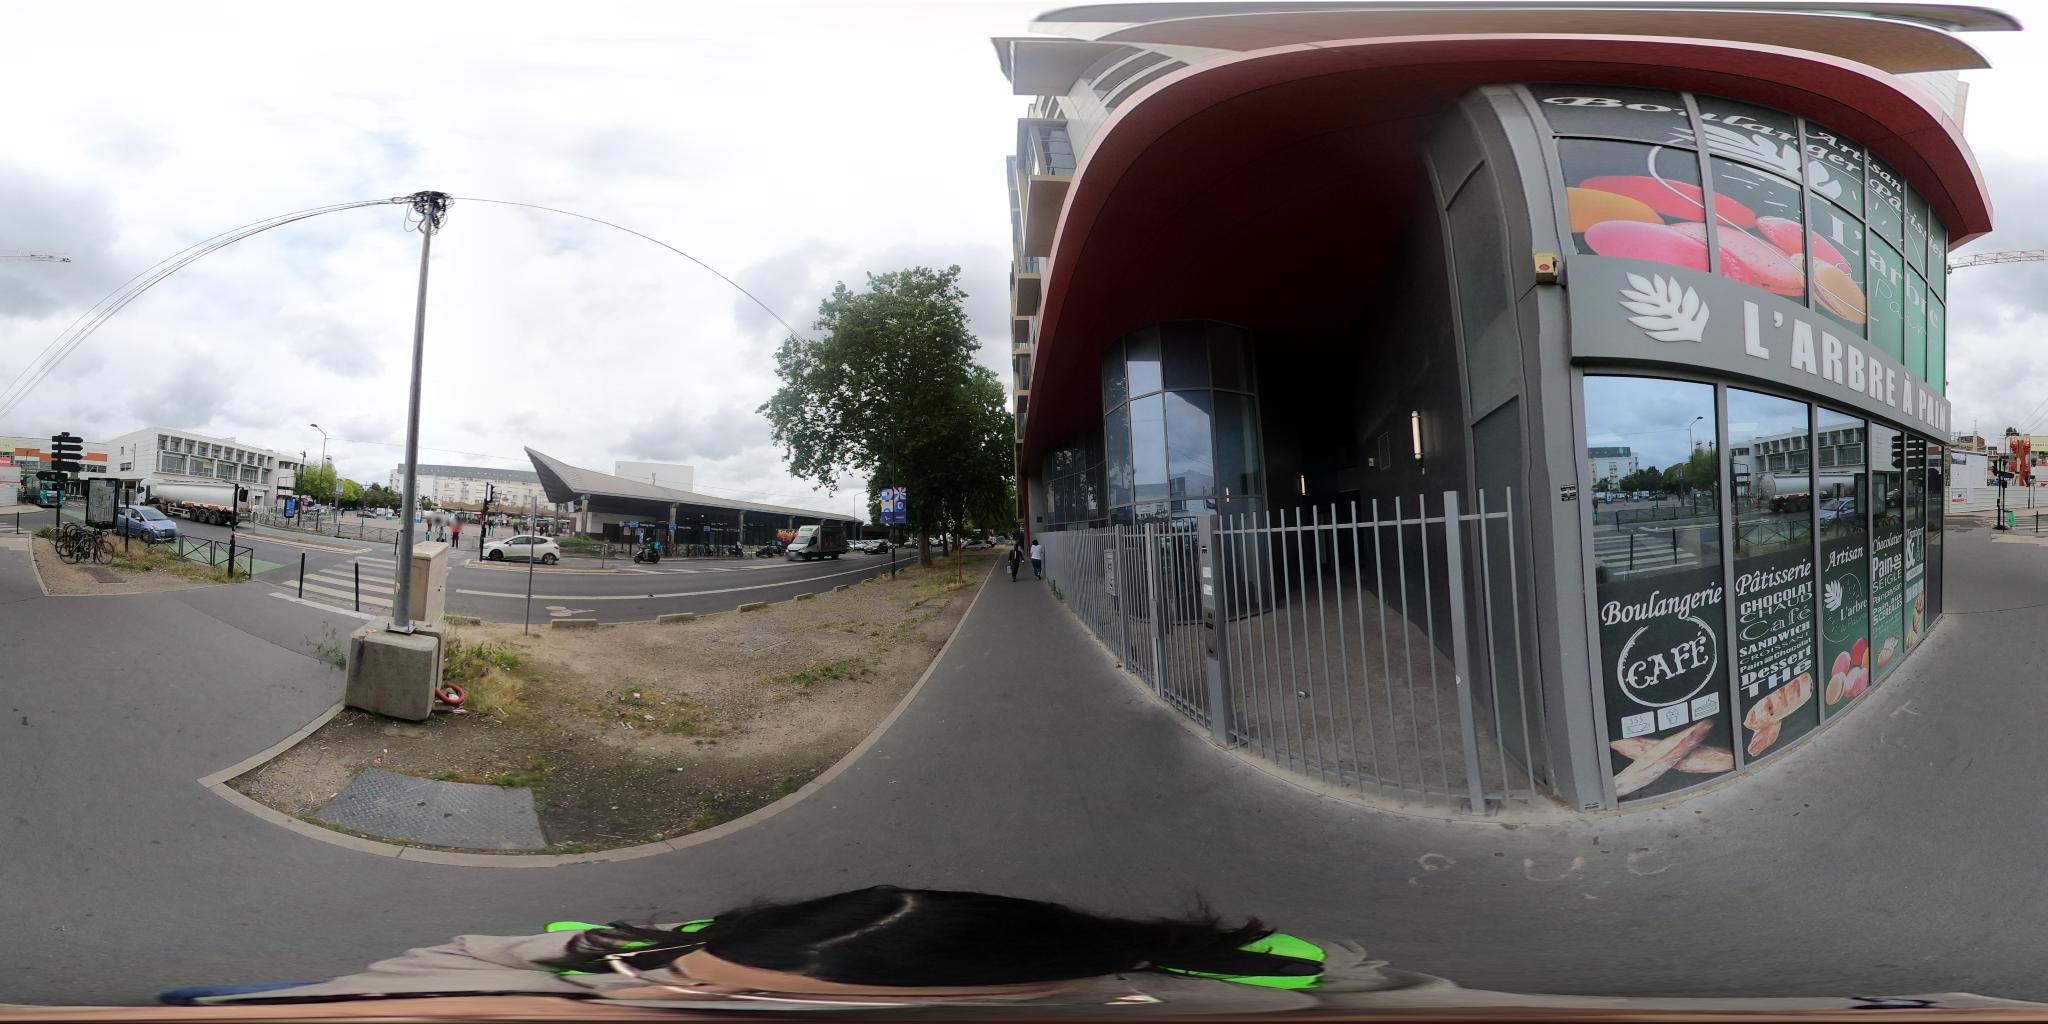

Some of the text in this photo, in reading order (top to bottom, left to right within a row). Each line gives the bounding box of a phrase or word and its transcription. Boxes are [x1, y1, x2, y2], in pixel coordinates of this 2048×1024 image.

[1542, 97, 1861, 172] Boulanger
[1806, 131, 1902, 193] Artisan
[1743, 300, 1946, 432] L'ARBRE À PAIN
[1735, 558, 1812, 597] Pâtisserie
[1824, 546, 1864, 573] Artisan
[1872, 552, 1892, 581] Pain
[1740, 580, 1813, 615] CHOCOLAT
[1872, 568, 1903, 594] SEIGLE
[1602, 582, 1723, 626] Boulangerie
[1740, 592, 1813, 624] CHAUD
[1740, 604, 1812, 641] Café
[1840, 599, 1868, 621] L'arbre
[1739, 620, 1811, 658] SANDWICH
[1739, 632, 1810, 665] CROISSANT
[1740, 657, 1764, 674] Pain
[1773, 637, 1812, 660] Chocolat
[1625, 631, 1709, 689] CAFÉ
[1741, 645, 1812, 687] Dessert
